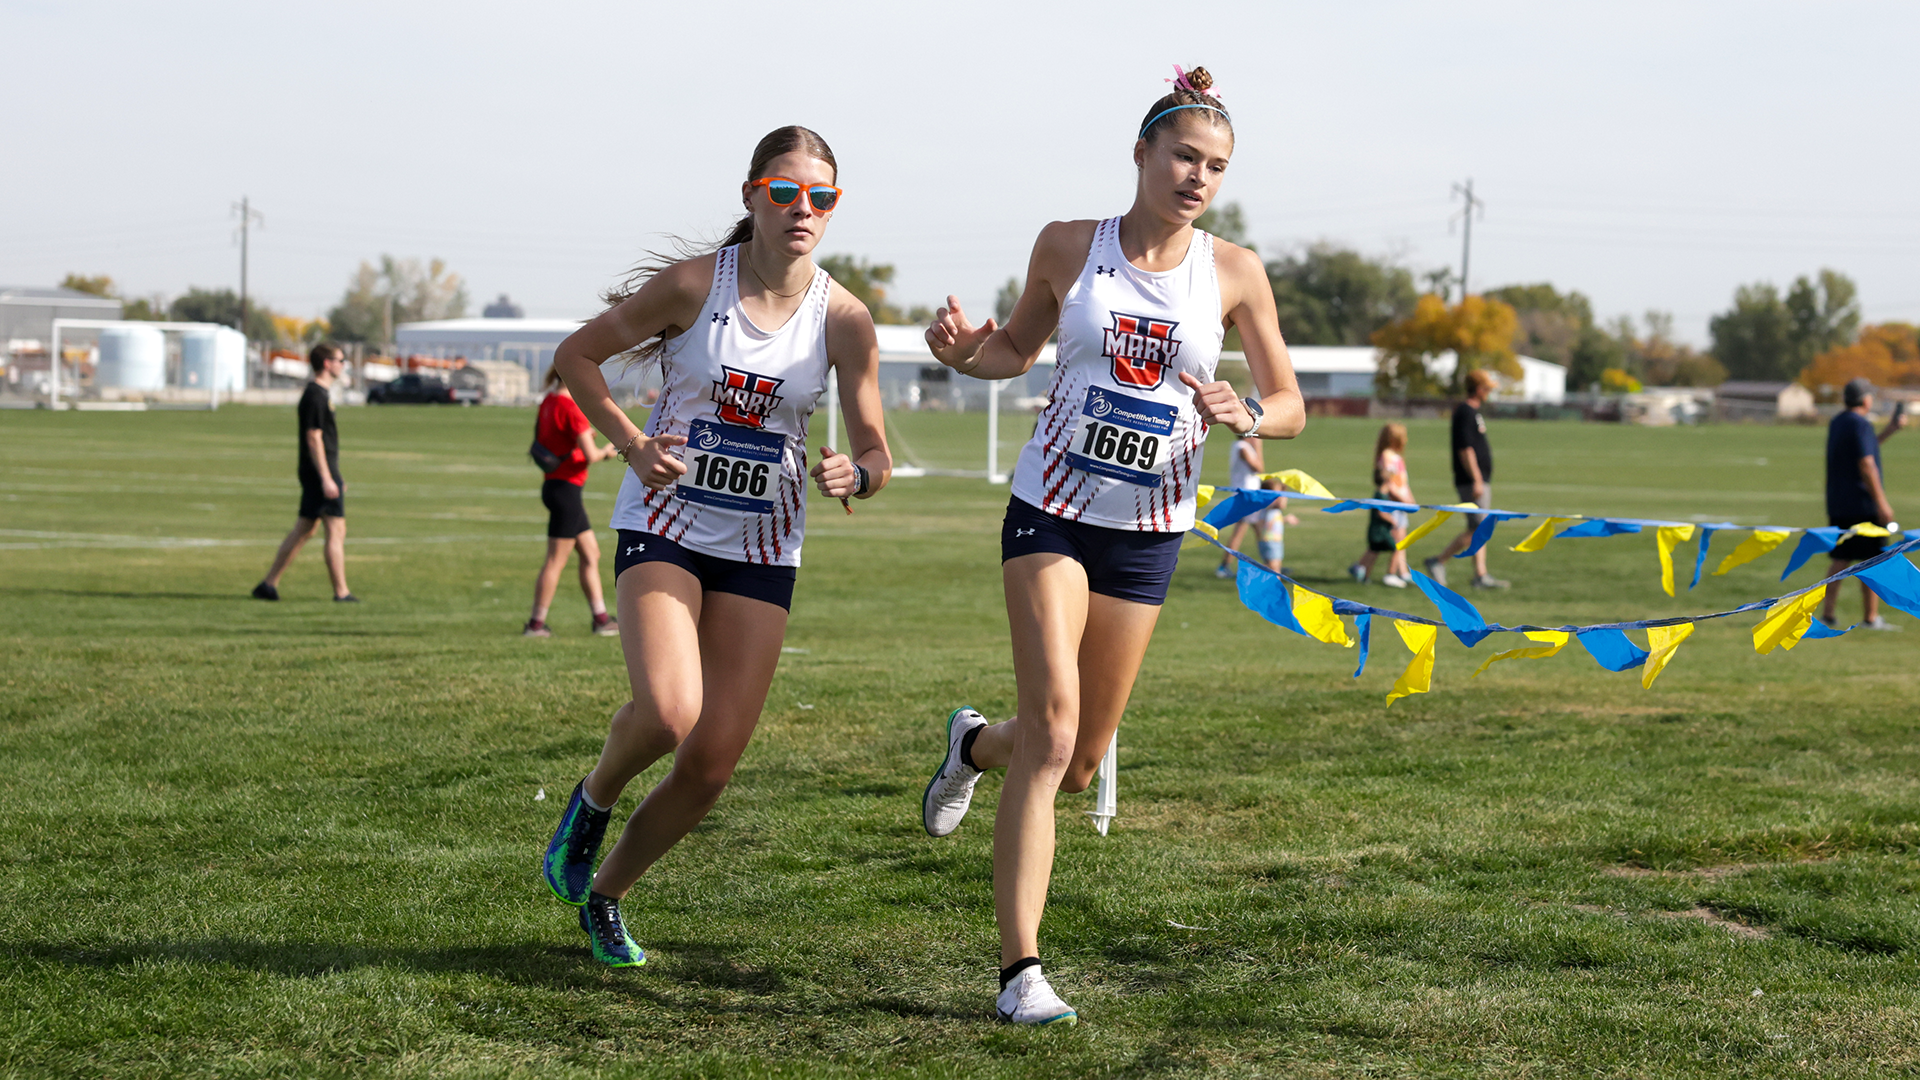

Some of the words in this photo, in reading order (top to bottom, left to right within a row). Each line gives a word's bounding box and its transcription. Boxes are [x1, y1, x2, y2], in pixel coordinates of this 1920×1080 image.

[1102, 327, 1182, 368] MARY
[711, 381, 784, 417] MARY
[1082, 421, 1159, 470] 1669
[694, 453, 770, 497] 1666
